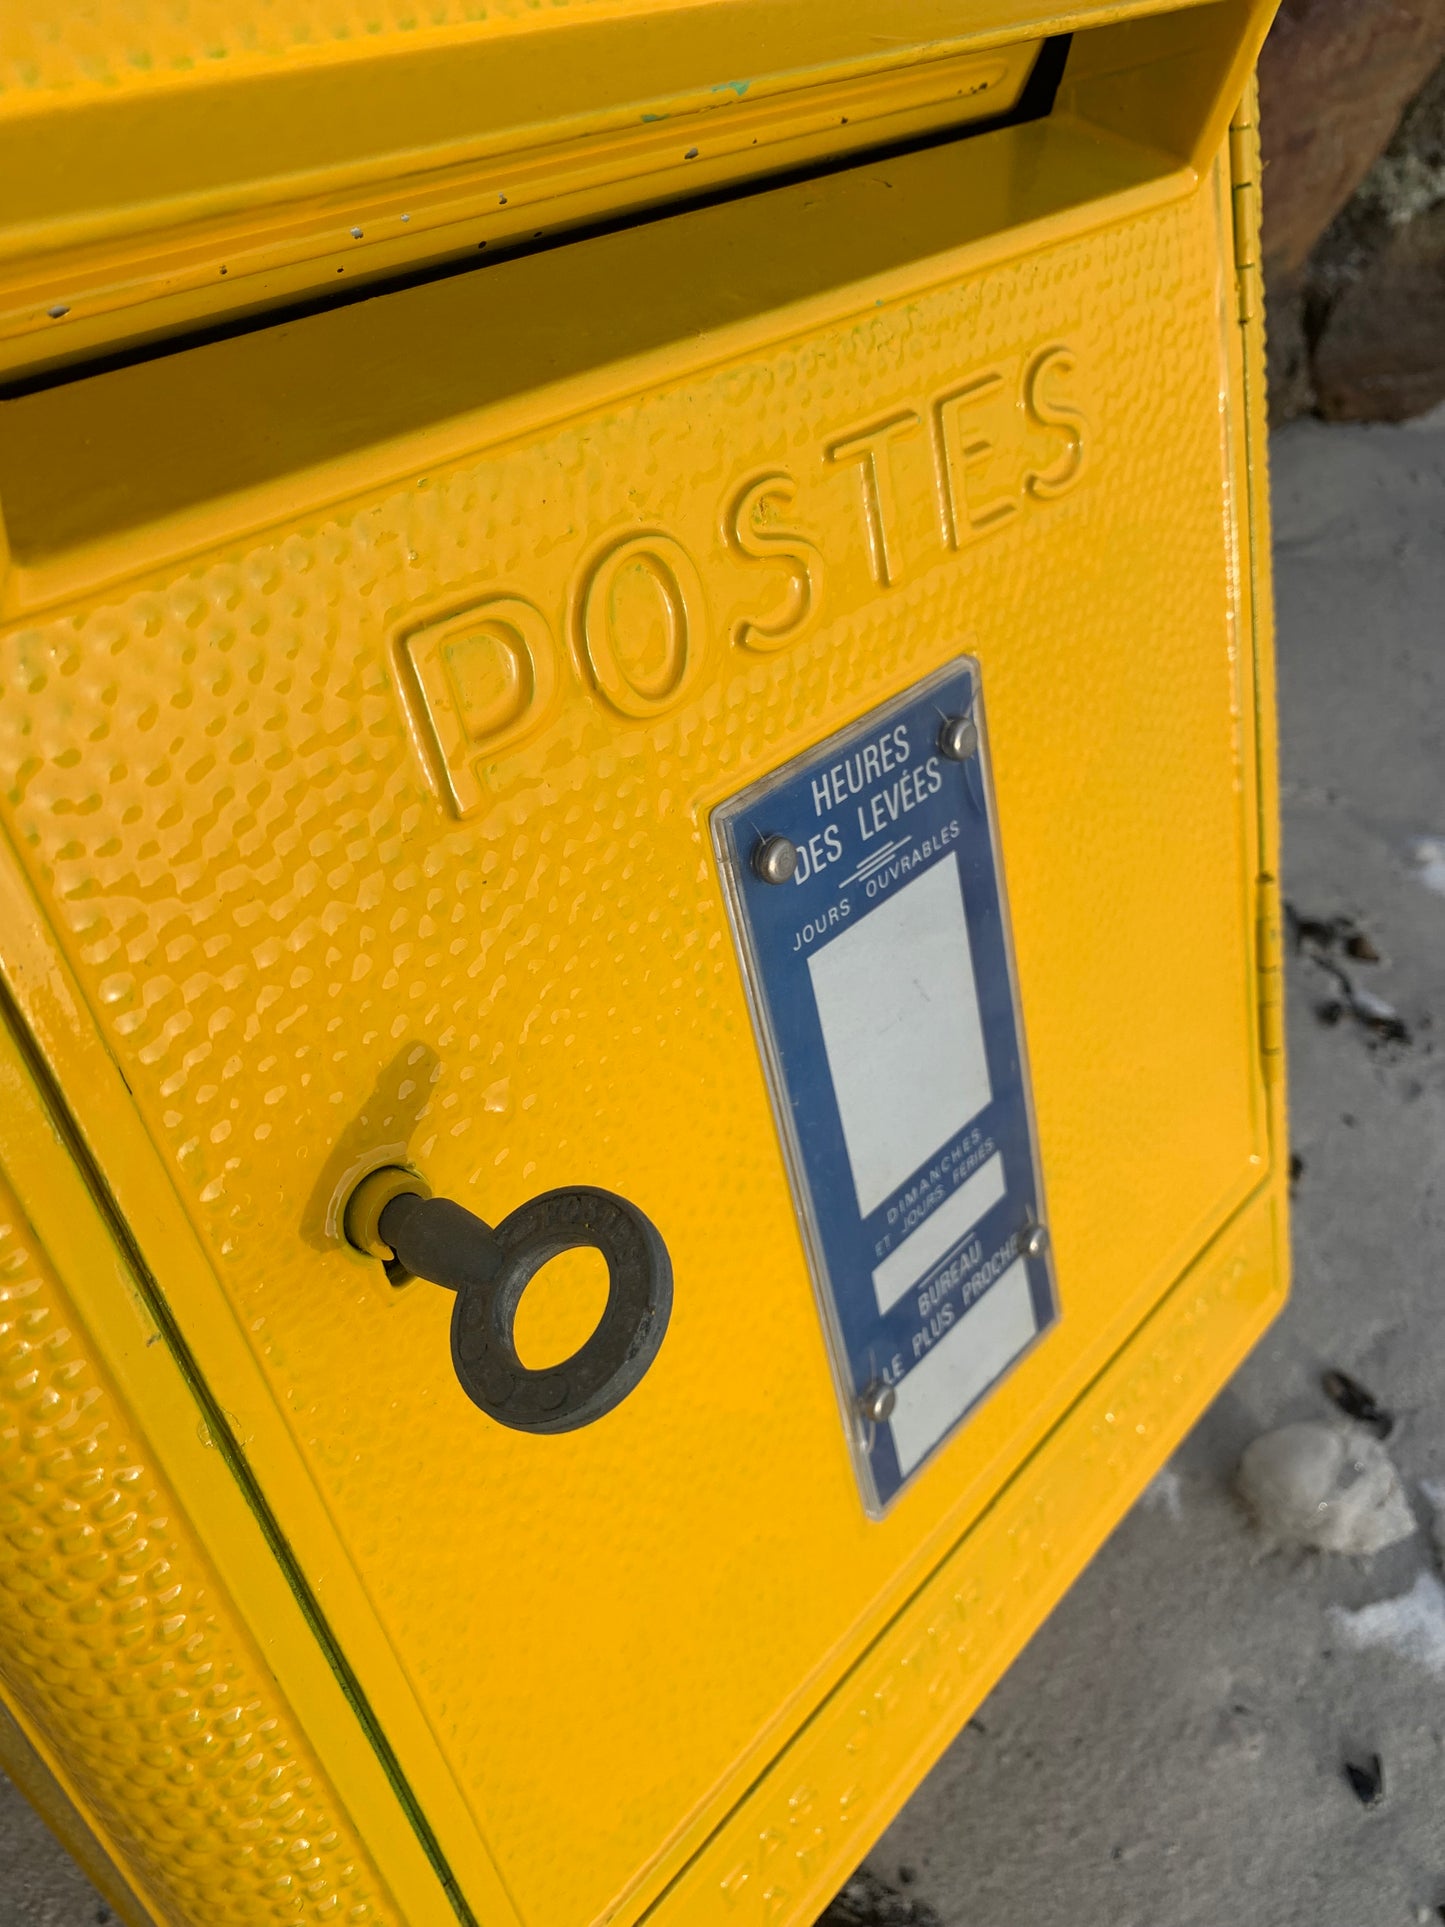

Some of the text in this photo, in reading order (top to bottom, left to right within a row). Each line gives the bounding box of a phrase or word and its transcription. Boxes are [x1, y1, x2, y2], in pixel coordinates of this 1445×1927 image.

[388, 344, 1092, 822] POSTES
[811, 725, 910, 816] HEURES
[794, 757, 943, 885] DES LEVÉES
[793, 820, 960, 951] JOURS OUVRABLES
[874, 1233, 892, 1256] ET
[902, 1184, 946, 1233] JOURS
[887, 1128, 982, 1225] DIMANCHES
[918, 1240, 983, 1317] BUREAU
[883, 1353, 905, 1385] LE
[912, 1303, 955, 1358] PLUS
